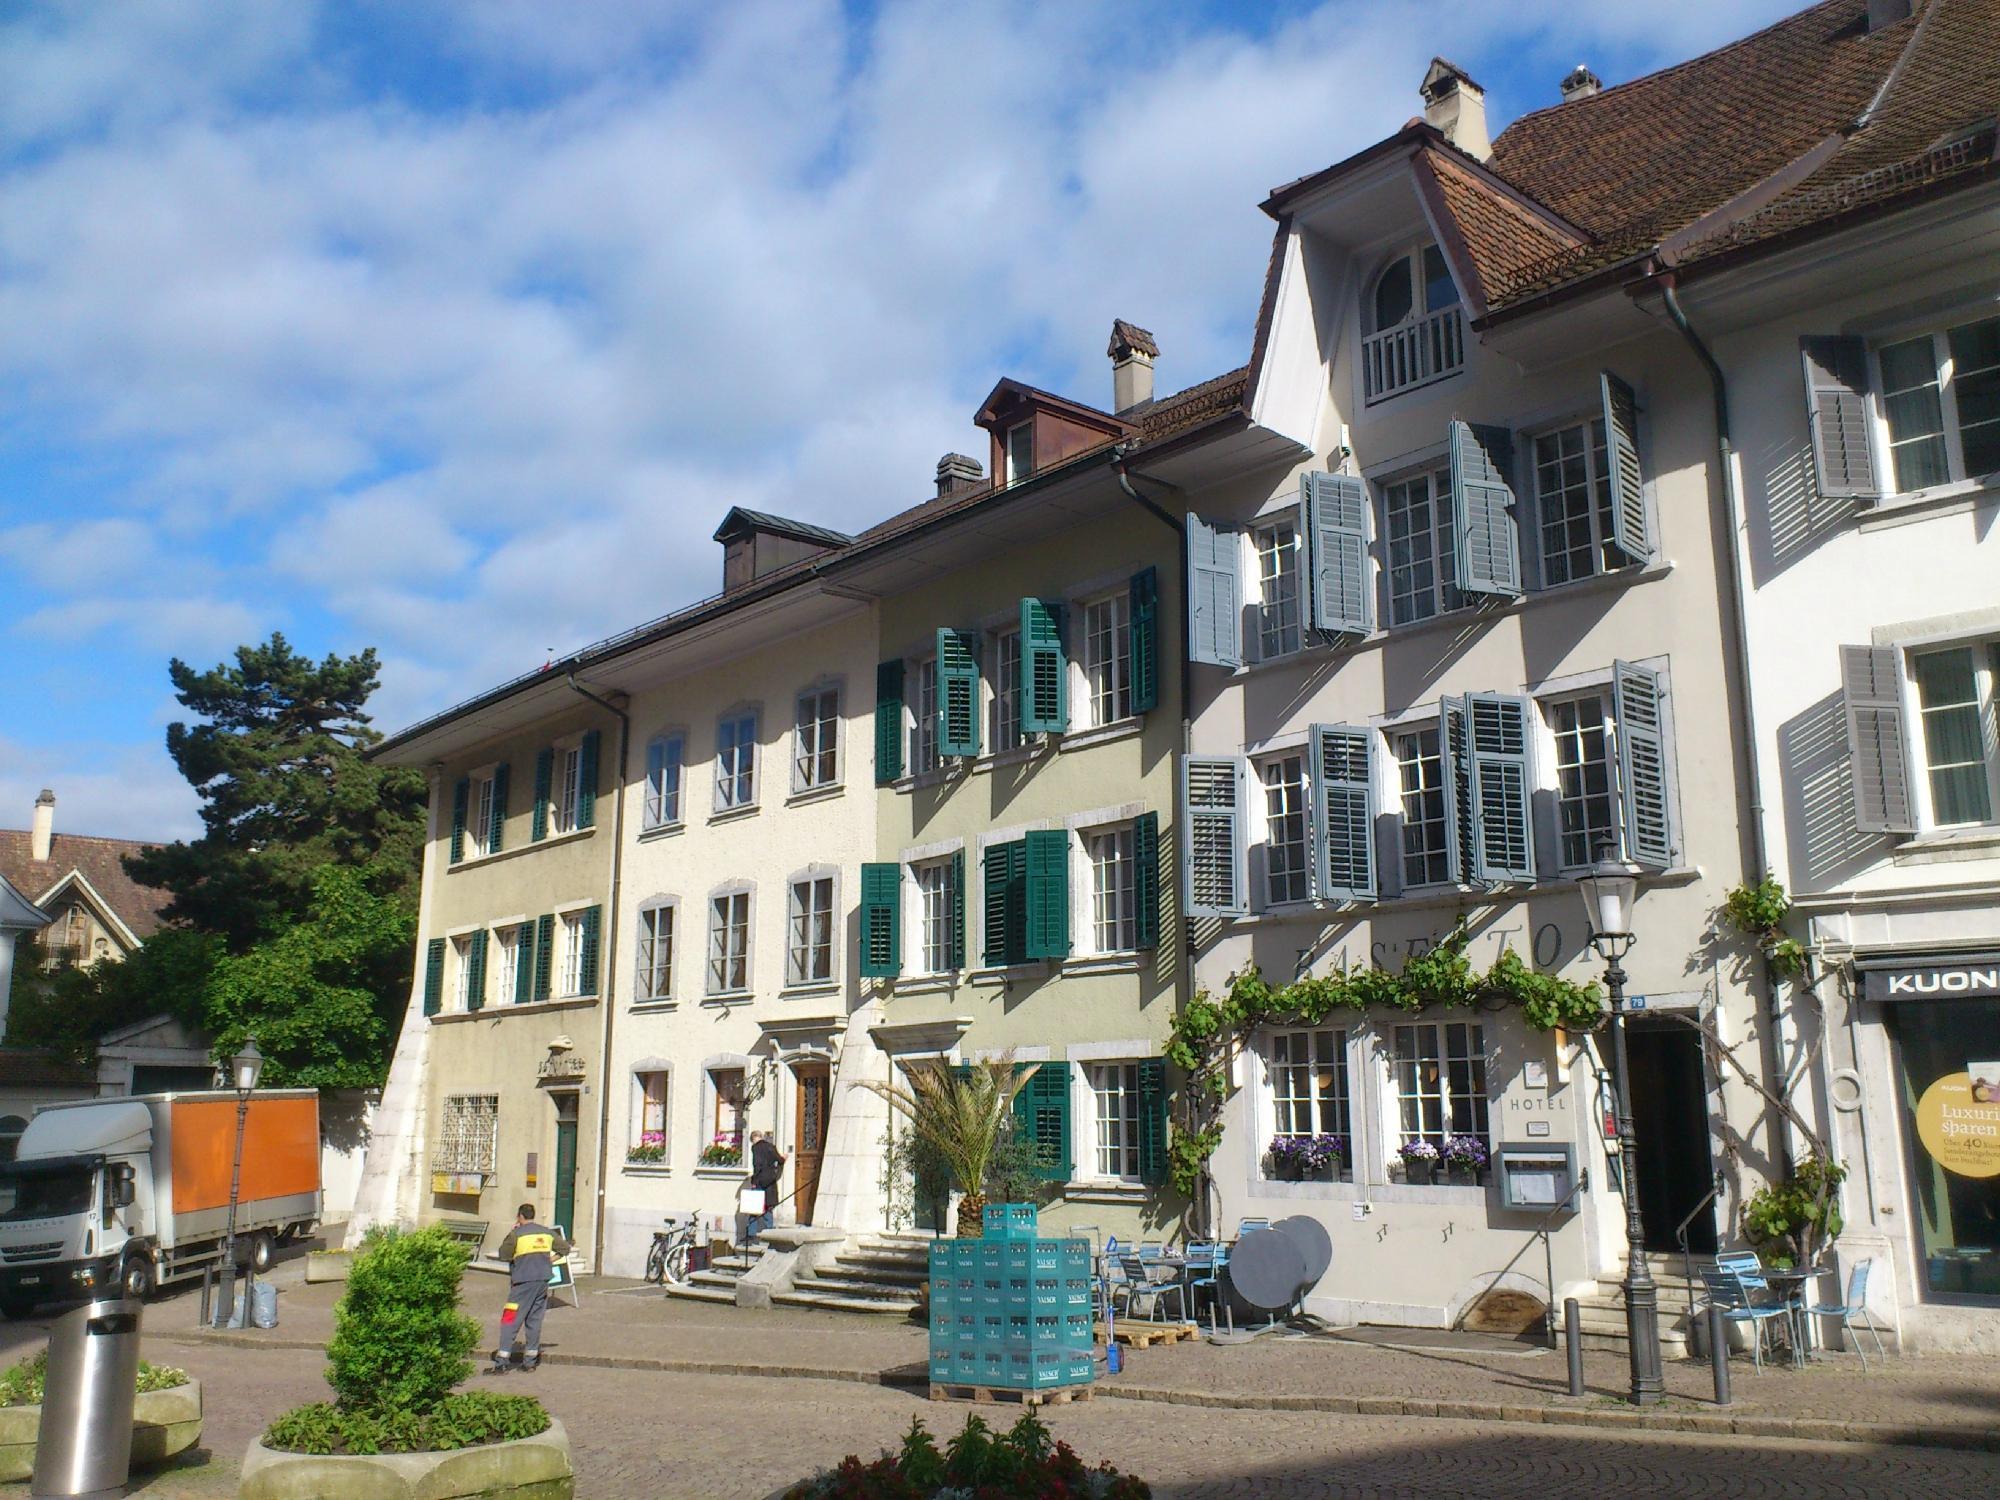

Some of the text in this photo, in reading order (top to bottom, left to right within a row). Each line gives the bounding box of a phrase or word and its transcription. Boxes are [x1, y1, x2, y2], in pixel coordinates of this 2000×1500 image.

[1889, 970, 2000, 994] KUON
[1631, 998, 1643, 1007] 79
[1510, 1098, 1566, 1111] HOTEL
[1942, 1103, 2000, 1120] Luxuri
[1942, 1120, 1997, 1137] sparen
[1963, 1138, 1982, 1150] 40
